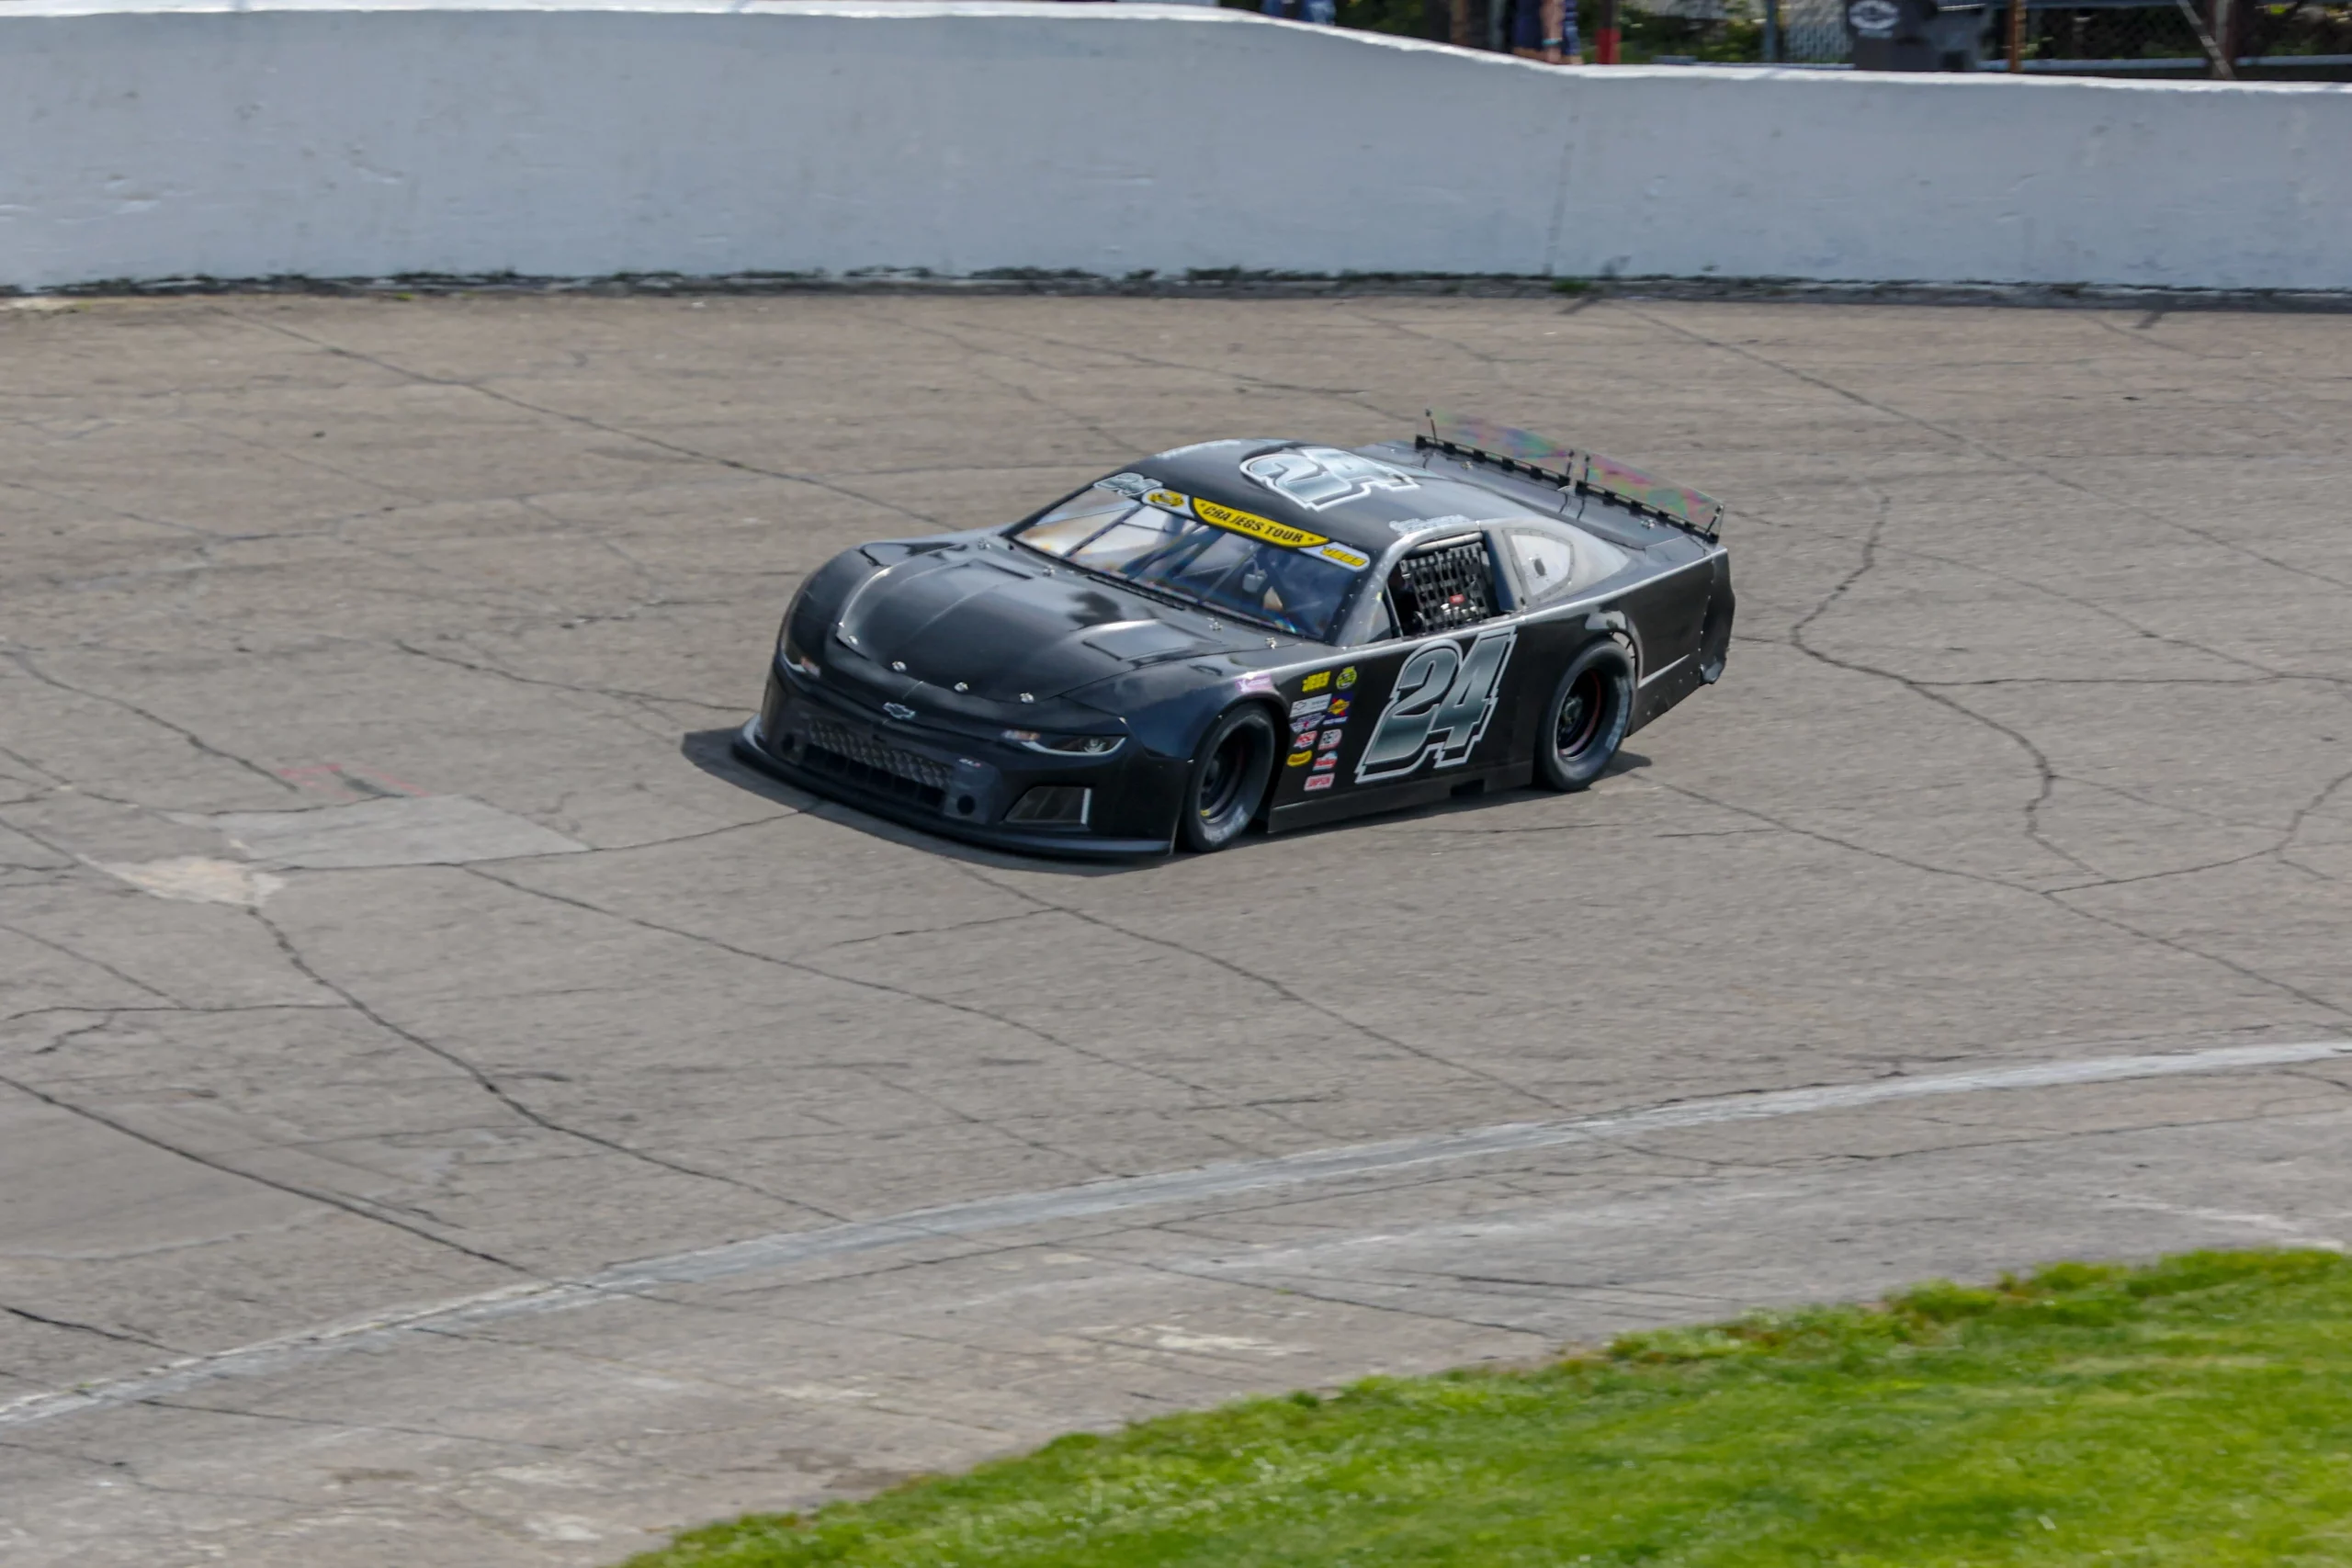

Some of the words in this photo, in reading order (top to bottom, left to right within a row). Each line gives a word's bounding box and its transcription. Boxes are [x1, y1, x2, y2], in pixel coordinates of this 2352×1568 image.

[1239, 447, 1420, 512] 24
[1203, 505, 1232, 522] CRA
[1231, 515, 1264, 531] JEGS
[1265, 525, 1304, 542] TOUR
[1353, 625, 1519, 784] 24
